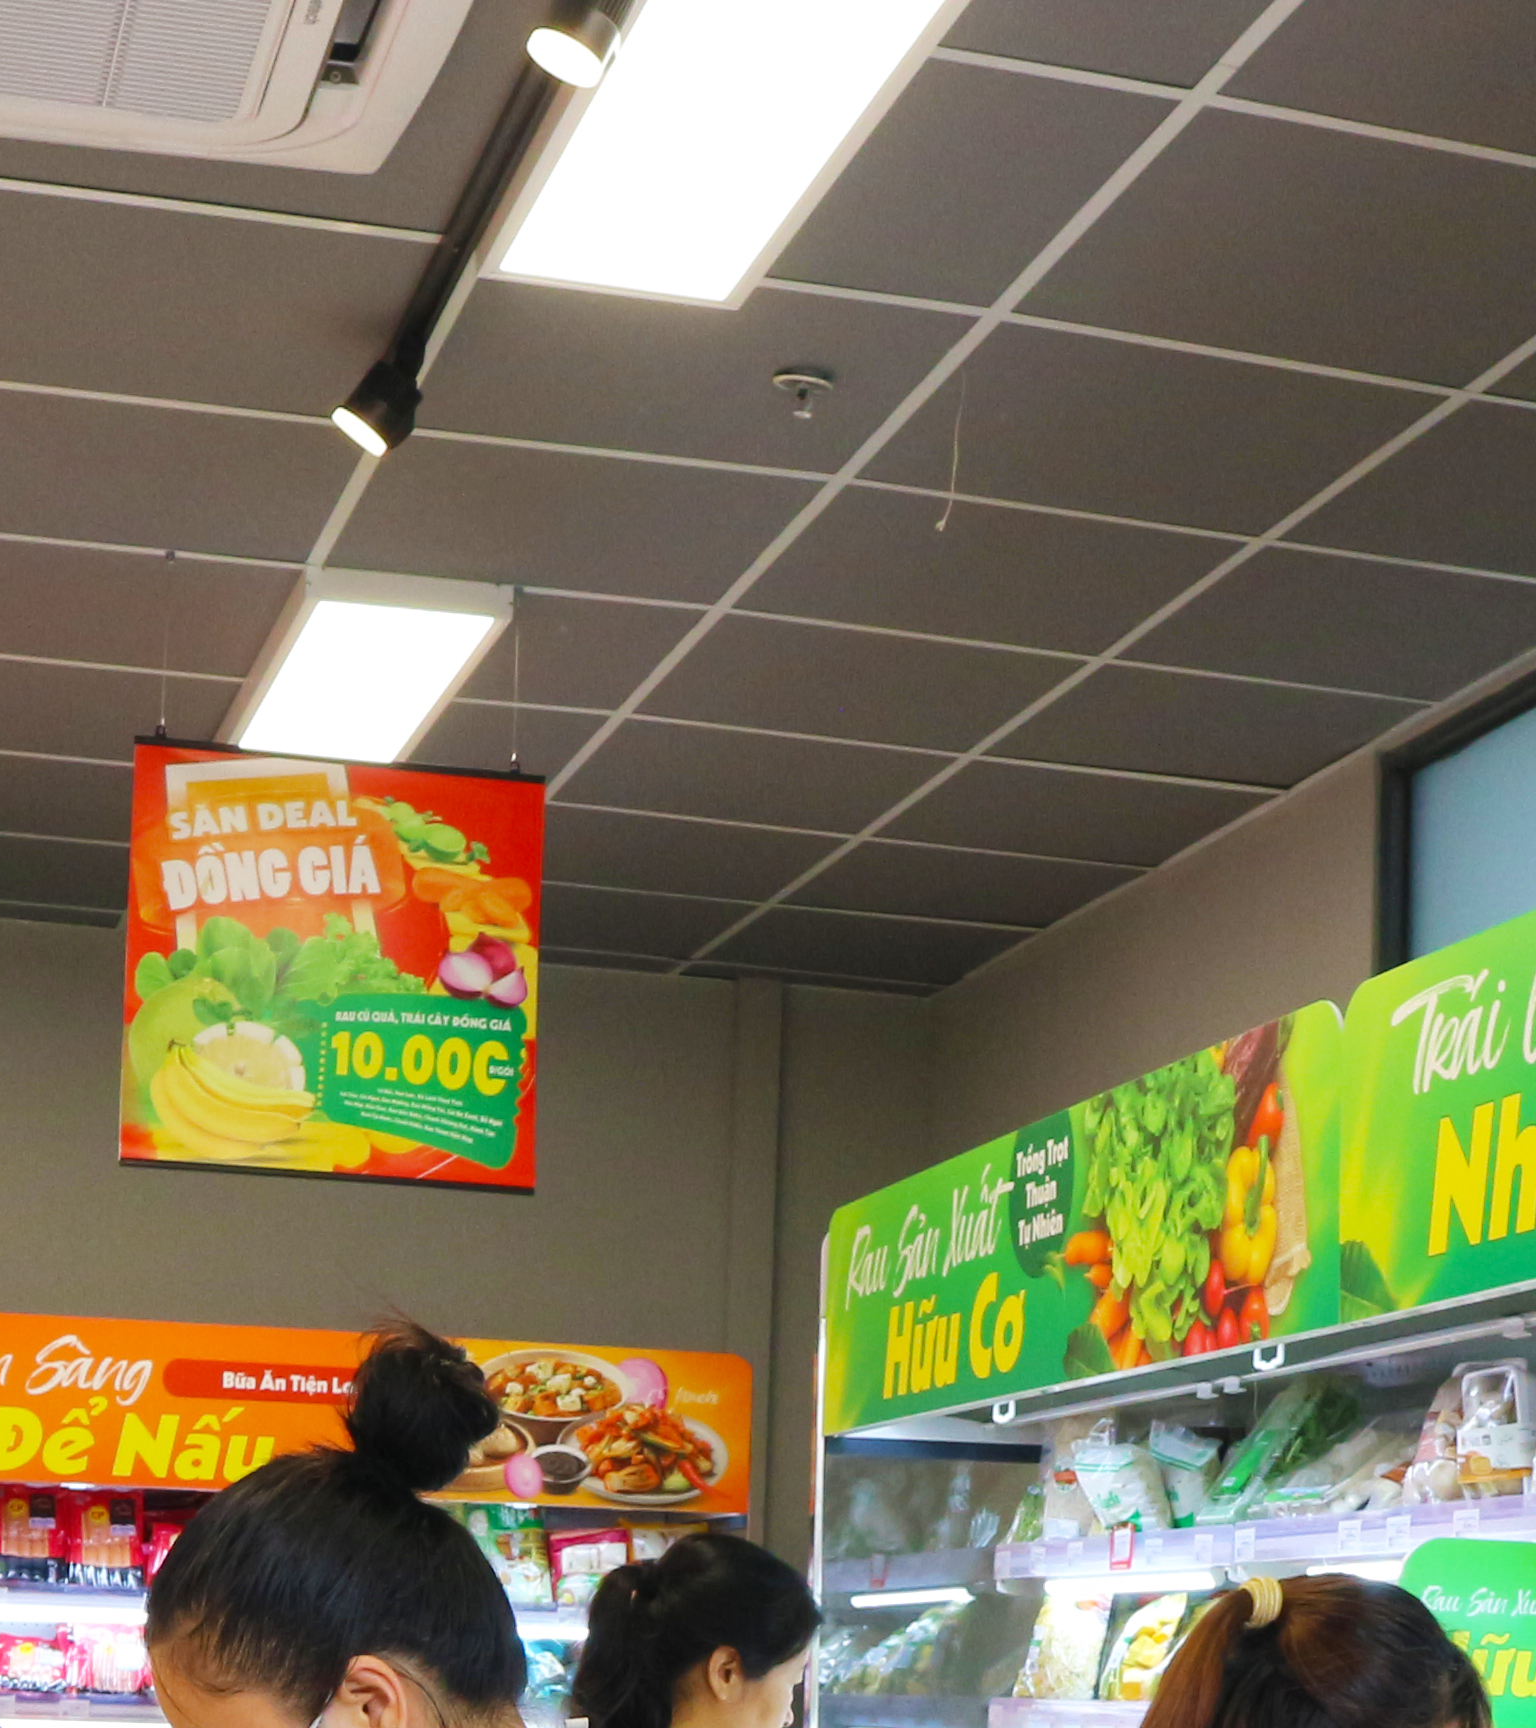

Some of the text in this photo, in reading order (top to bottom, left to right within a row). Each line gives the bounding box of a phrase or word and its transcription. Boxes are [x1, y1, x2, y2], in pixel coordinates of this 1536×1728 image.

[257, 800, 357, 831] DEAL
[162, 834, 381, 911] ĐỒNG GIÁ
[1391, 970, 1508, 1093] Trái
[25, 1334, 154, 1406] Sàng
[883, 1272, 1026, 1399] Hữu Cơ
[222, 1370, 328, 1396] Bữa Ăn Tiện
[113, 1407, 275, 1483] Nấu
